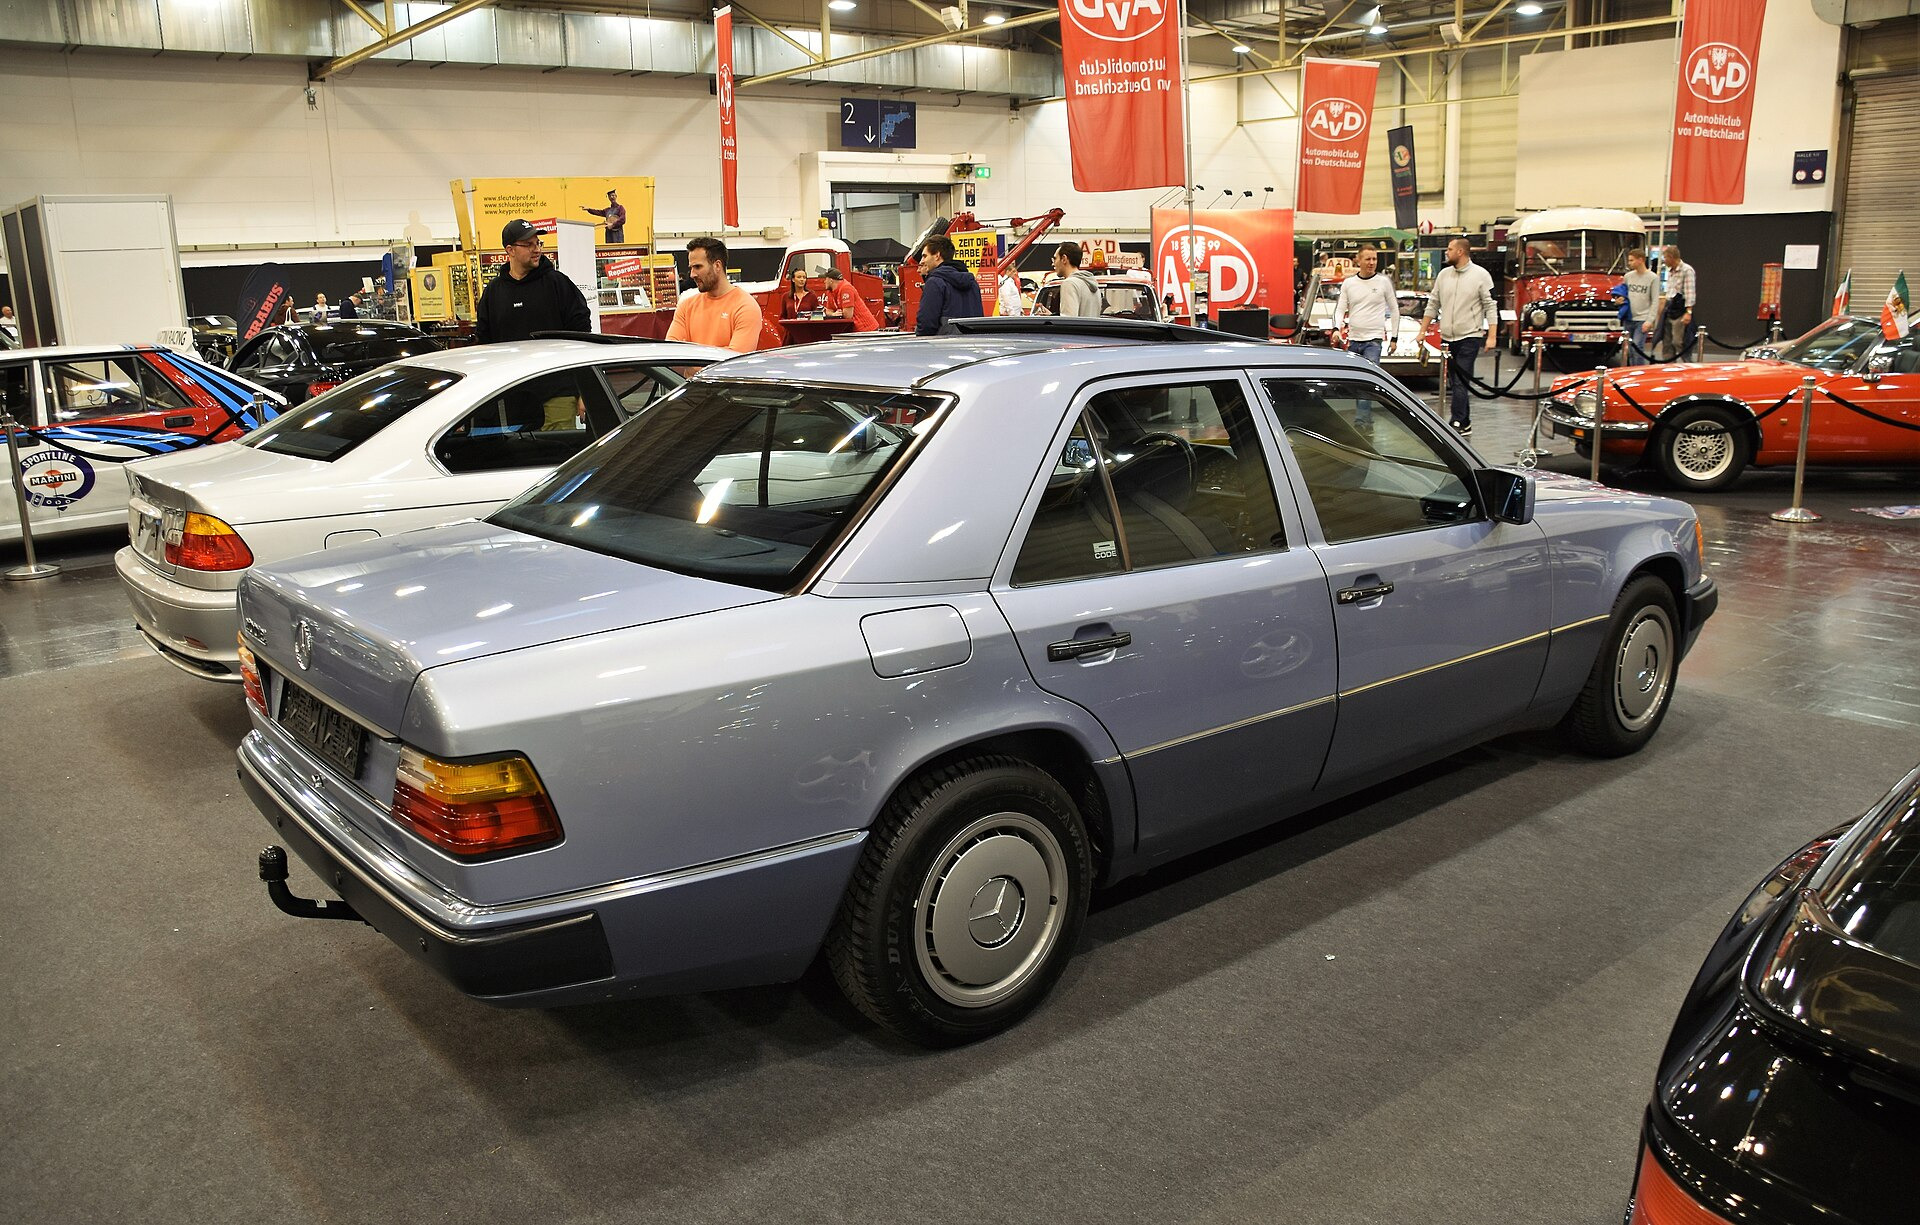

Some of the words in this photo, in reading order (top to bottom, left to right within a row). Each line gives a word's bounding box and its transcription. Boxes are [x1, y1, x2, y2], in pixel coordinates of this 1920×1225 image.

[844, 102, 856, 124] 2
[1314, 158, 1362, 168] Deutschland
[958, 238, 975, 247] ZEIT
[976, 237, 988, 246] DIE
[1171, 240, 1179, 251] 18
[1207, 240, 1220, 251] 99
[954, 249, 980, 258] FARBE
[982, 247, 993, 256] ZU
[963, 259, 996, 268] CHSELN
[1107, 255, 1138, 265] Hilfsdienst
[608, 265, 640, 277] Reparatur
[244, 284, 283, 340] BRABUS
[21, 451, 76, 469] SPORTLINE
[31, 472, 76, 485] MARTINI
[1094, 550, 1117, 560] CODE
